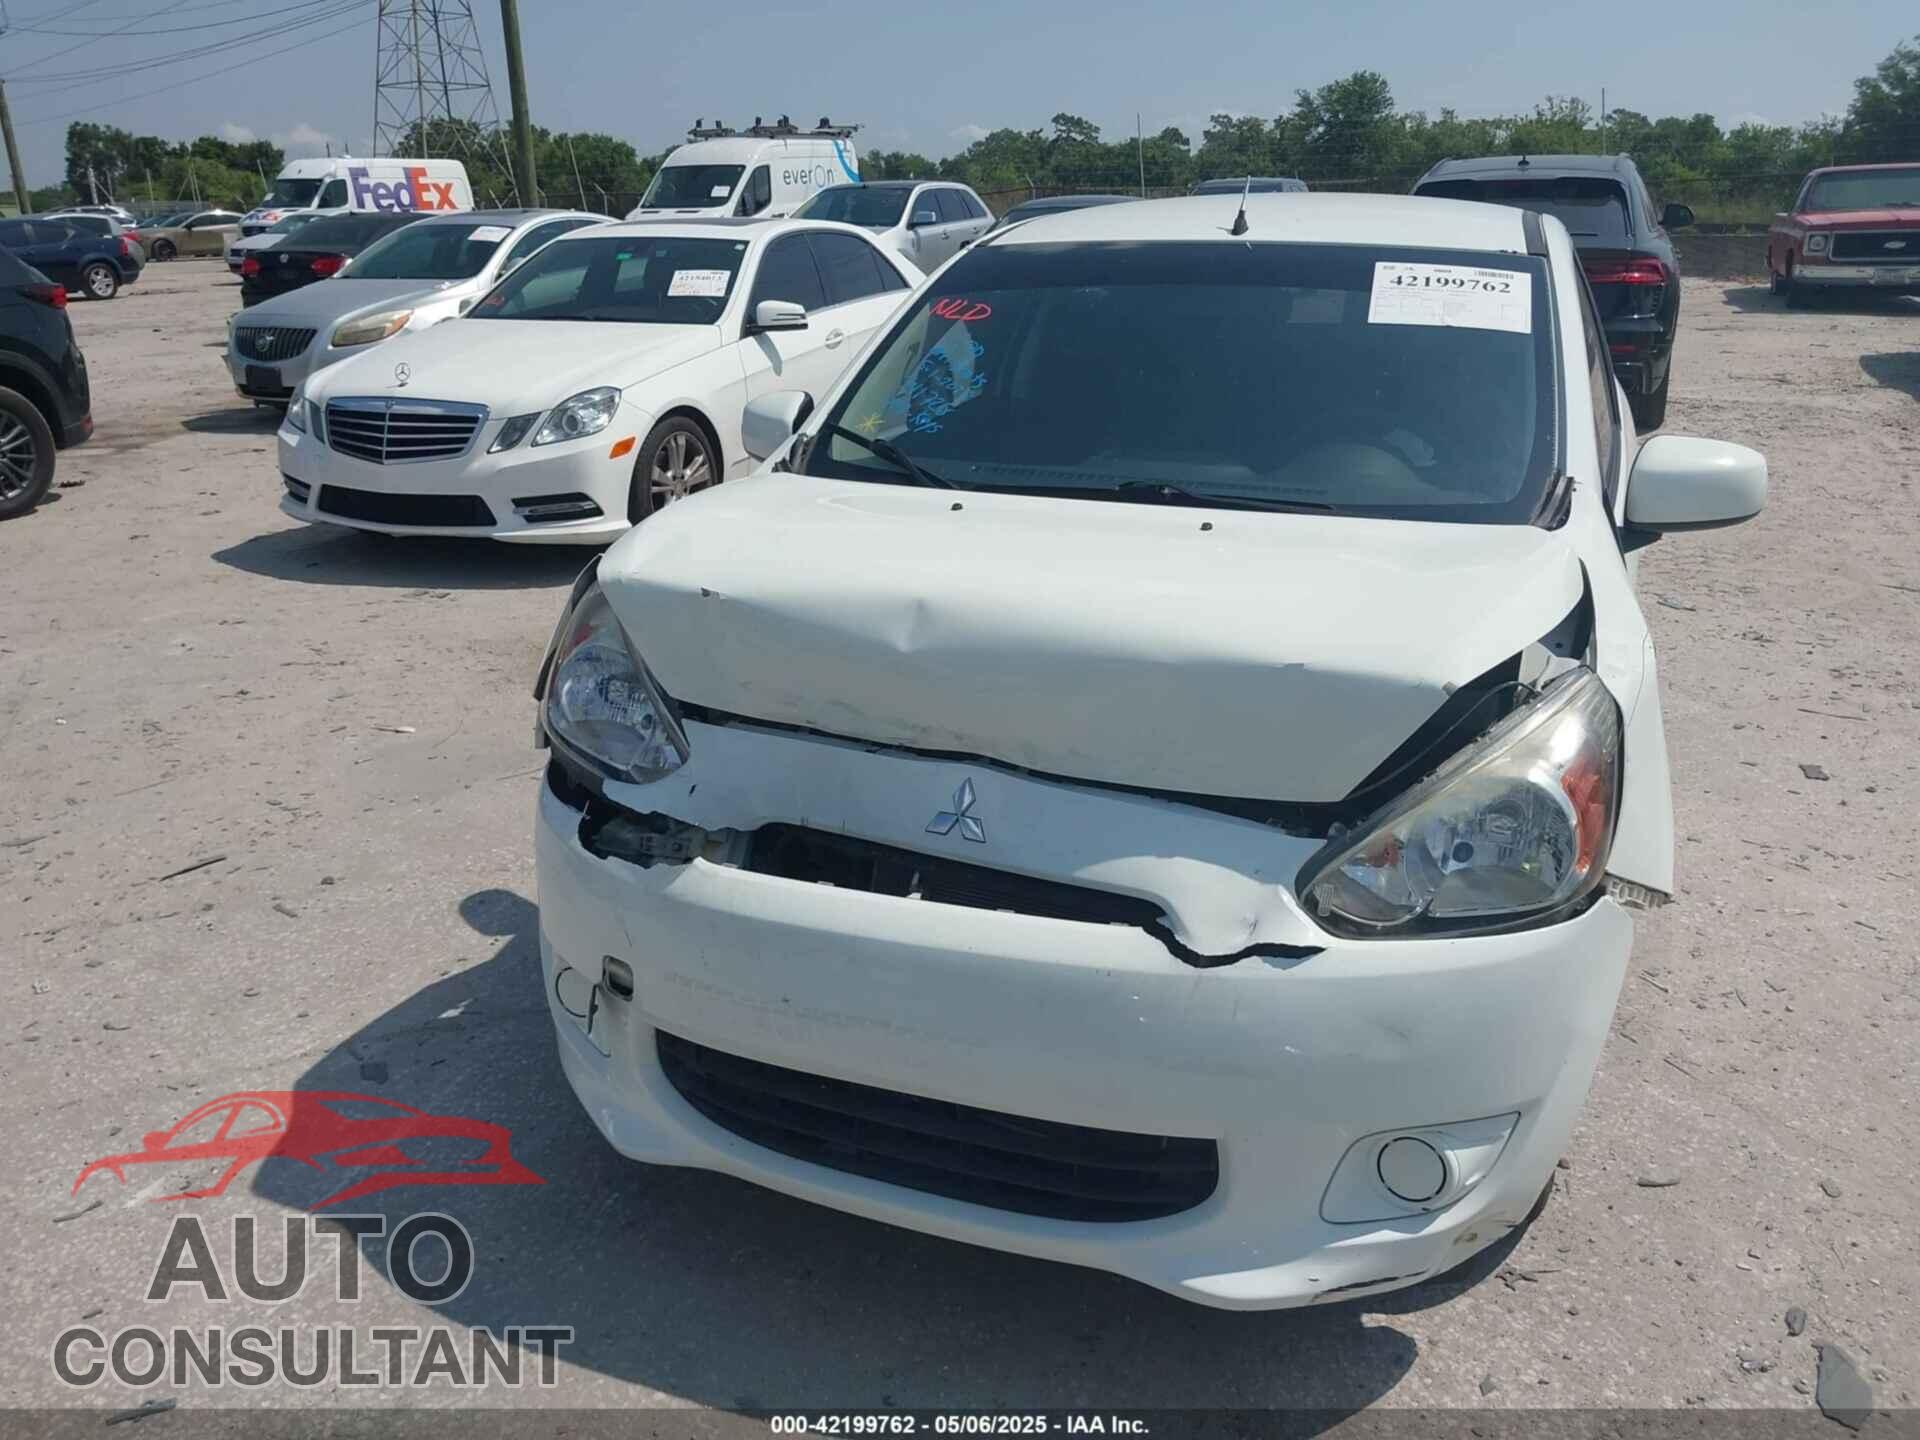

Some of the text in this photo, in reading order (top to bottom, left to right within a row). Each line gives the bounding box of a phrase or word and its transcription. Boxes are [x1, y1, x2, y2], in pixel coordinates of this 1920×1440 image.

[783, 164, 834, 188] everOn
[348, 167, 458, 212] FedEx
[1389, 274, 1511, 293] 42199762
